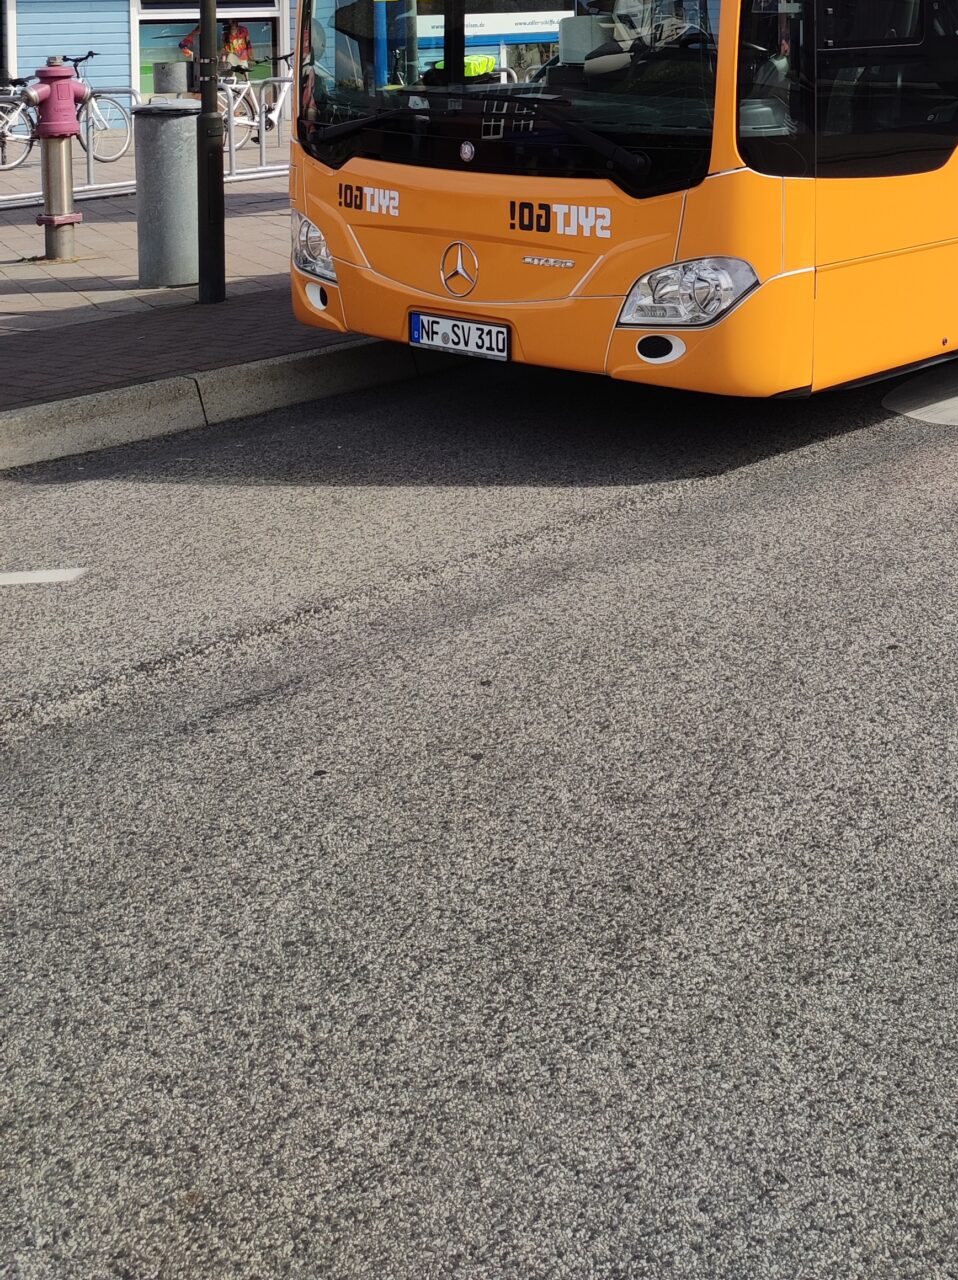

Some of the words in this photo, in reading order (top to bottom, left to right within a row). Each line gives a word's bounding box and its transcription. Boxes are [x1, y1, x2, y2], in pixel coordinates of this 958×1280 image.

[421, 318, 440, 342] NF
[451, 323, 471, 347] SV
[475, 327, 506, 353] 310
